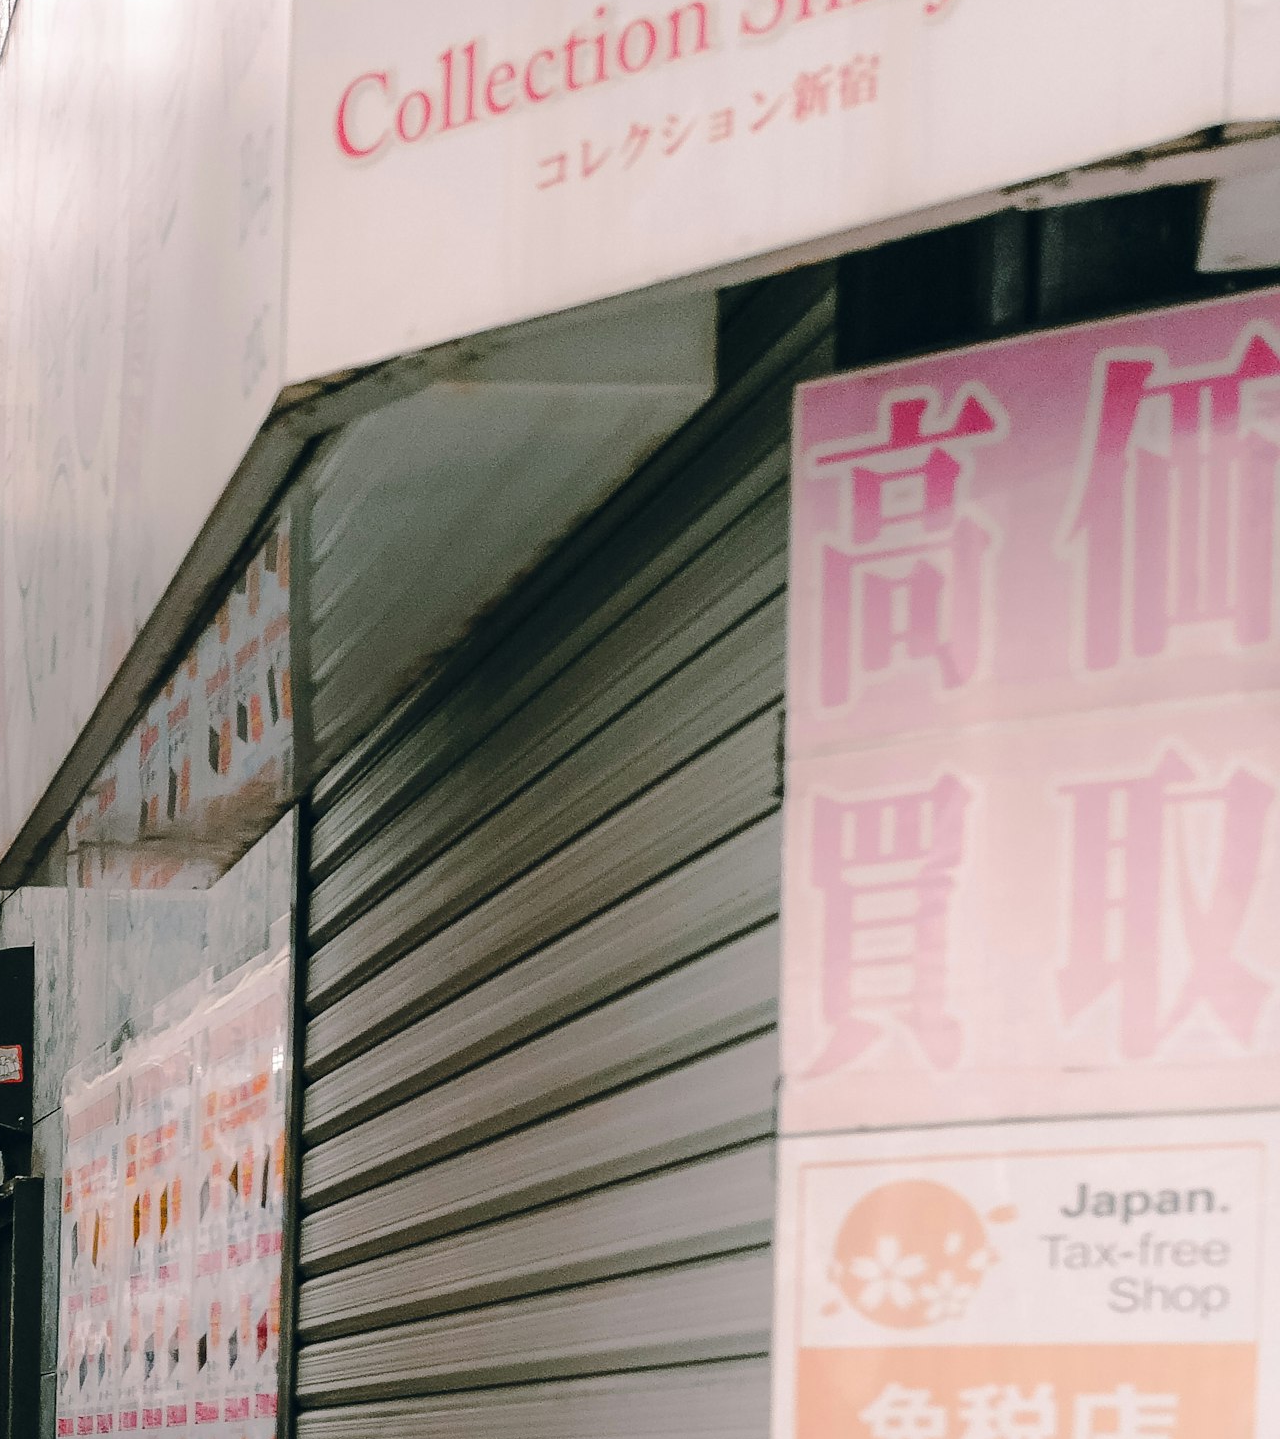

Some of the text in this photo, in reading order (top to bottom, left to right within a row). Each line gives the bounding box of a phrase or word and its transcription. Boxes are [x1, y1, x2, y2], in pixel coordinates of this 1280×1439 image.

[534, 53, 883, 191] コレクション新宿
[796, 747, 1276, 1082] 買取
[1060, 1183, 1229, 1224] Japan.
[1040, 1233, 1229, 1272] Tax-free
[1107, 1276, 1229, 1319] Shop
